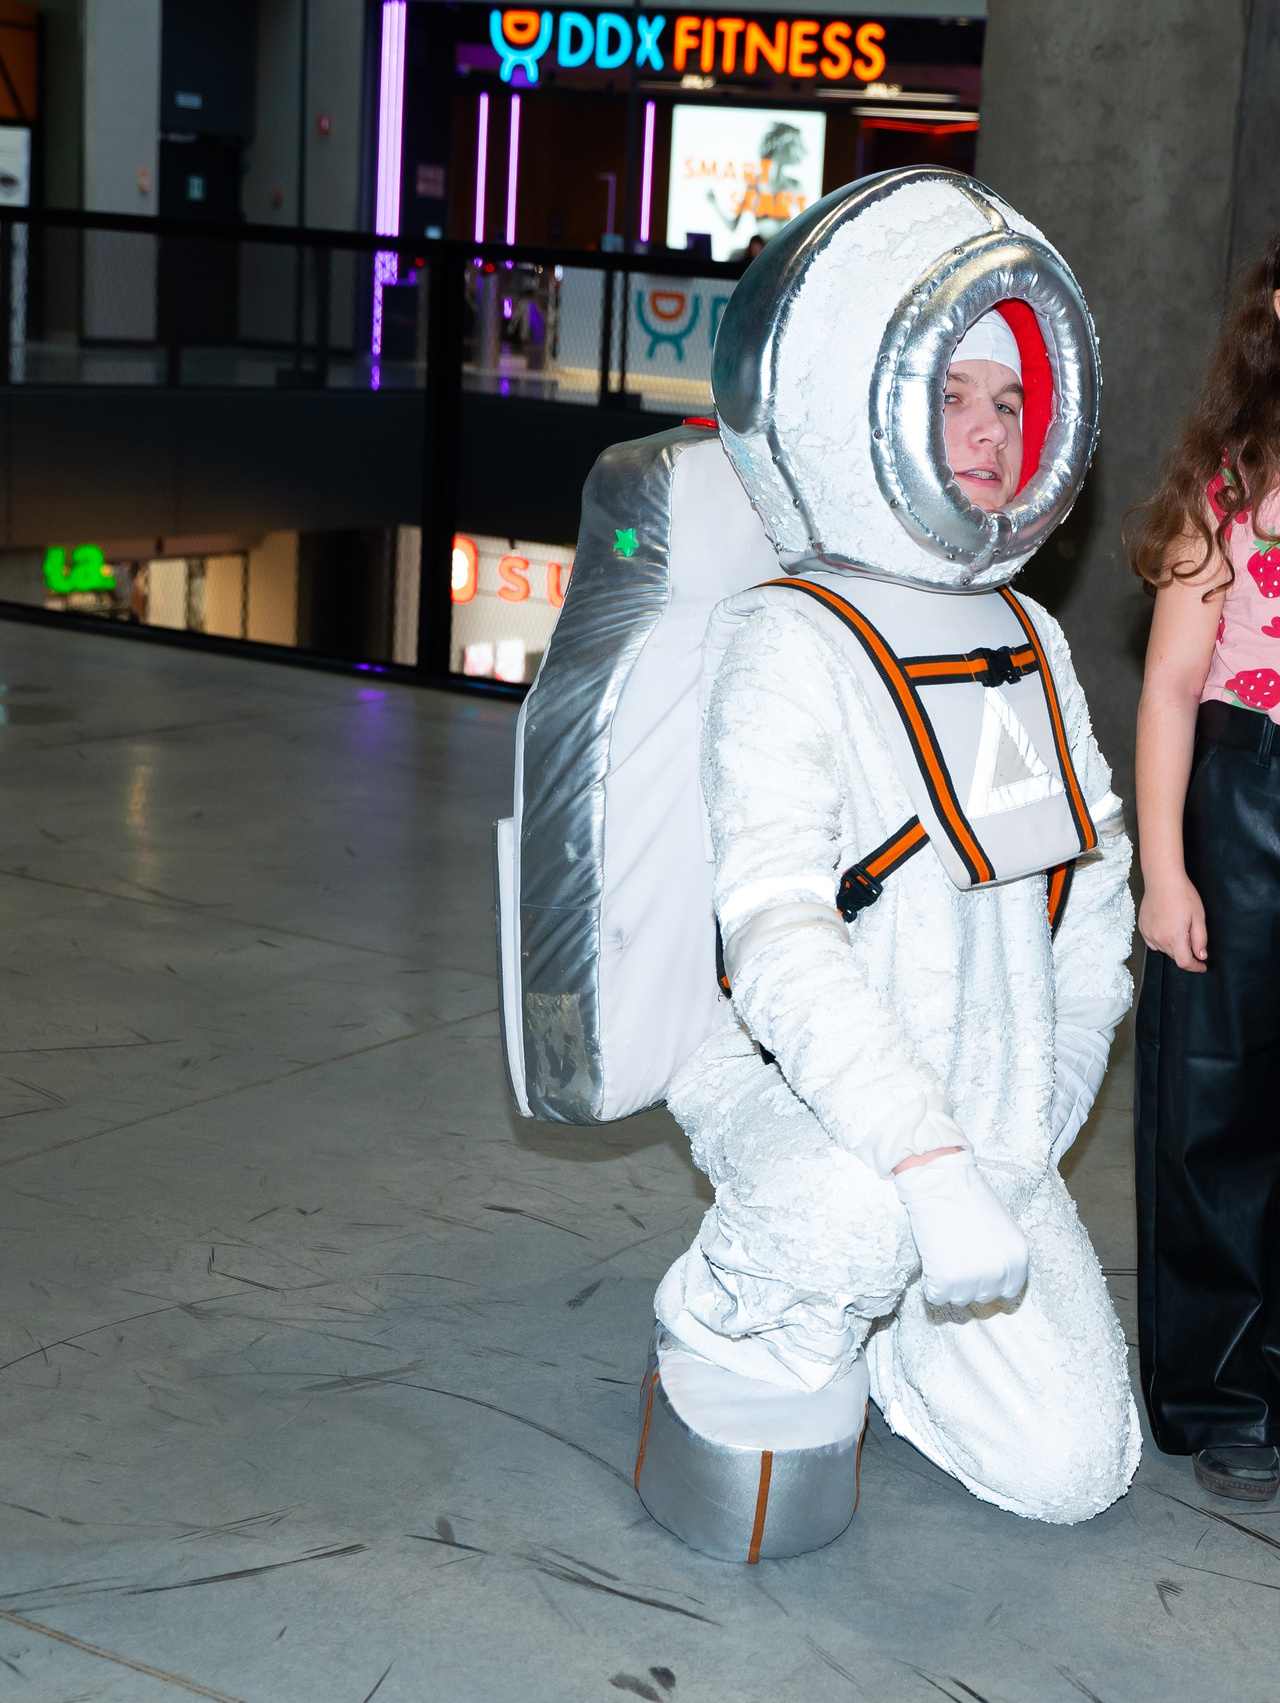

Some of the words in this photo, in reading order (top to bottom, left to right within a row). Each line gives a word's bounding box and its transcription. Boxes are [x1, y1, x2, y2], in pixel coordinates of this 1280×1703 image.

[558, 11, 666, 71] DDX
[673, 15, 886, 81] FITNESS
[683, 156, 772, 186] SMART
[730, 187, 807, 220] START
